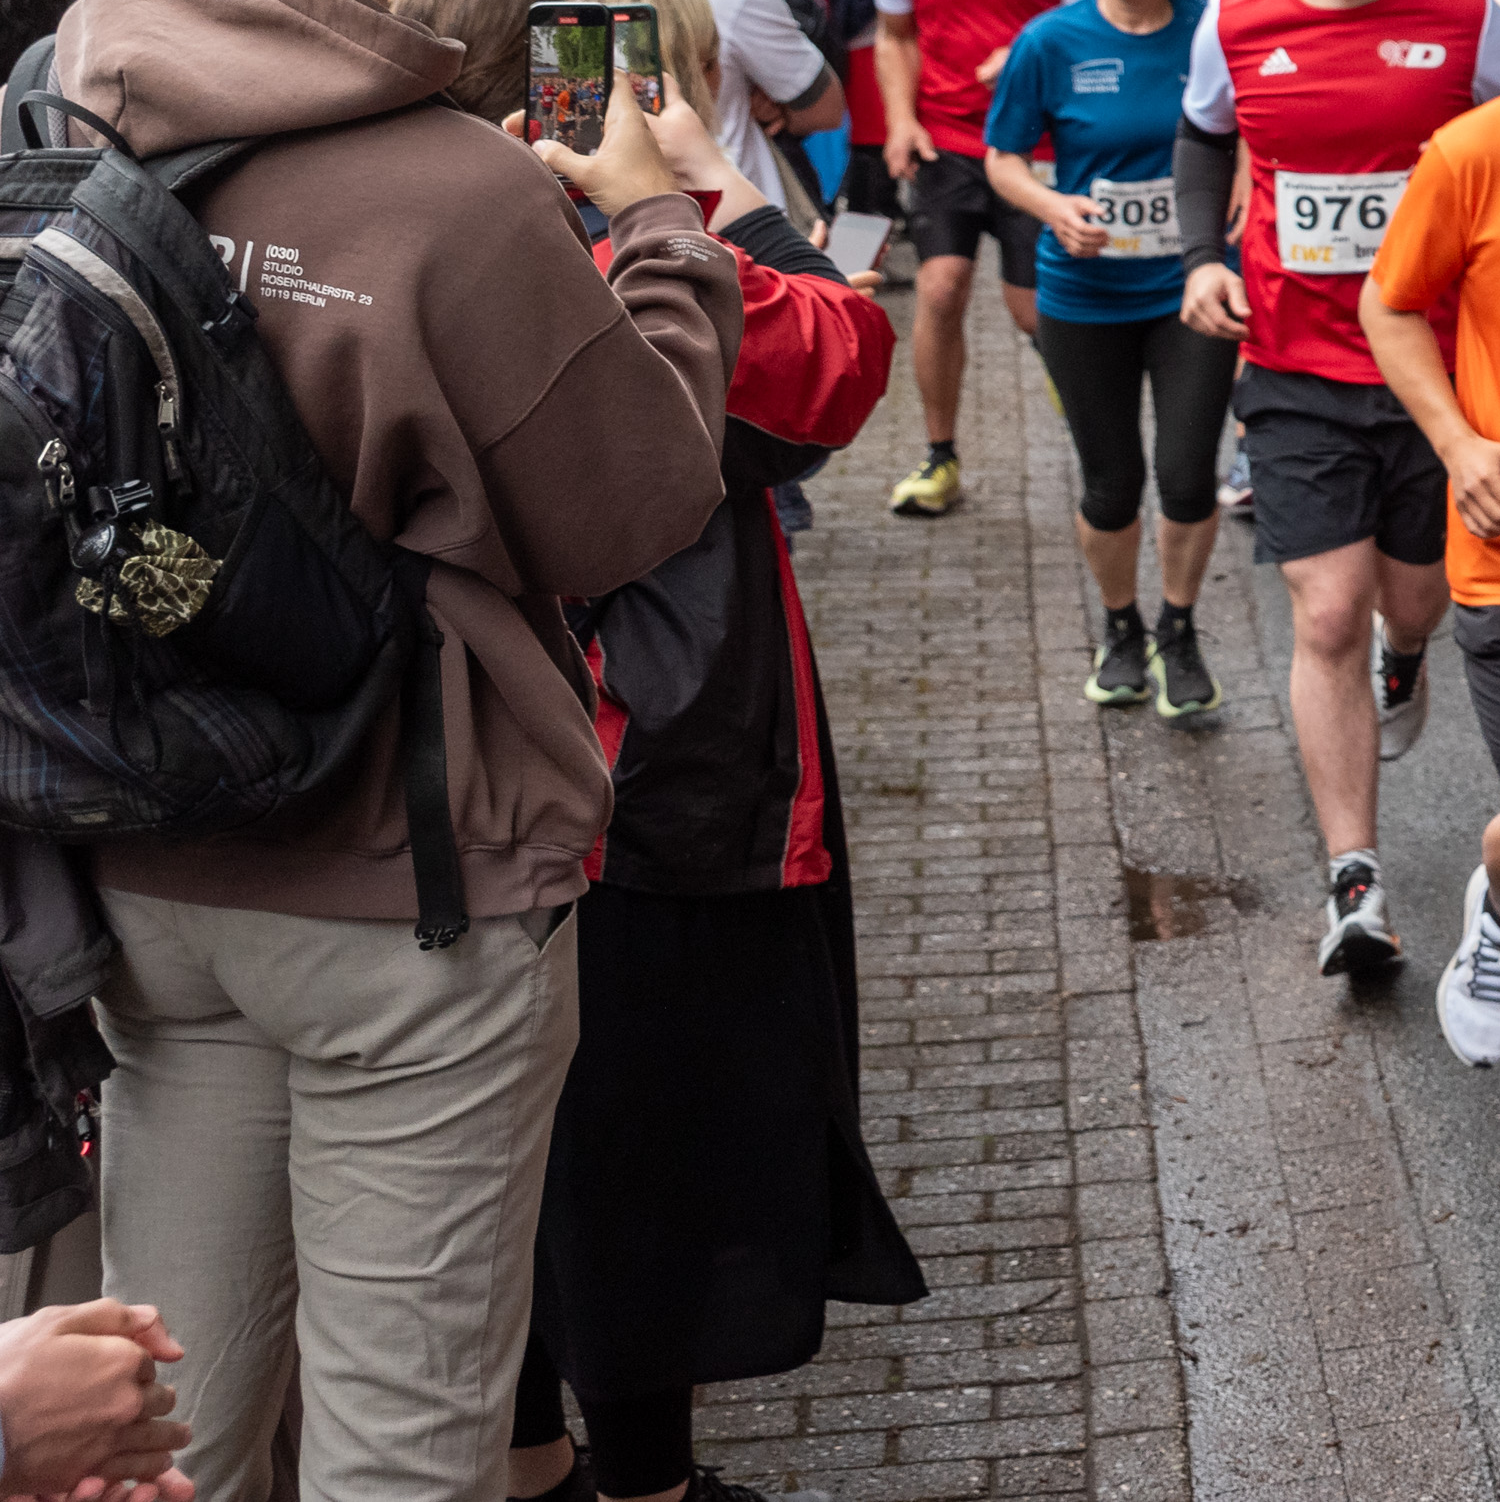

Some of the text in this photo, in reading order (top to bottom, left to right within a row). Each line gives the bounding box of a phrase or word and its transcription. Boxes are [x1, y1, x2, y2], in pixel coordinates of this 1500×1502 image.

[1294, 194, 1388, 231] 976
[265, 244, 300, 264] (030)
[262, 261, 304, 276] STUDIO
[260, 273, 374, 306] ROSENTHALERSTR. 23
[260, 286, 327, 308] 10119 BERLIN
